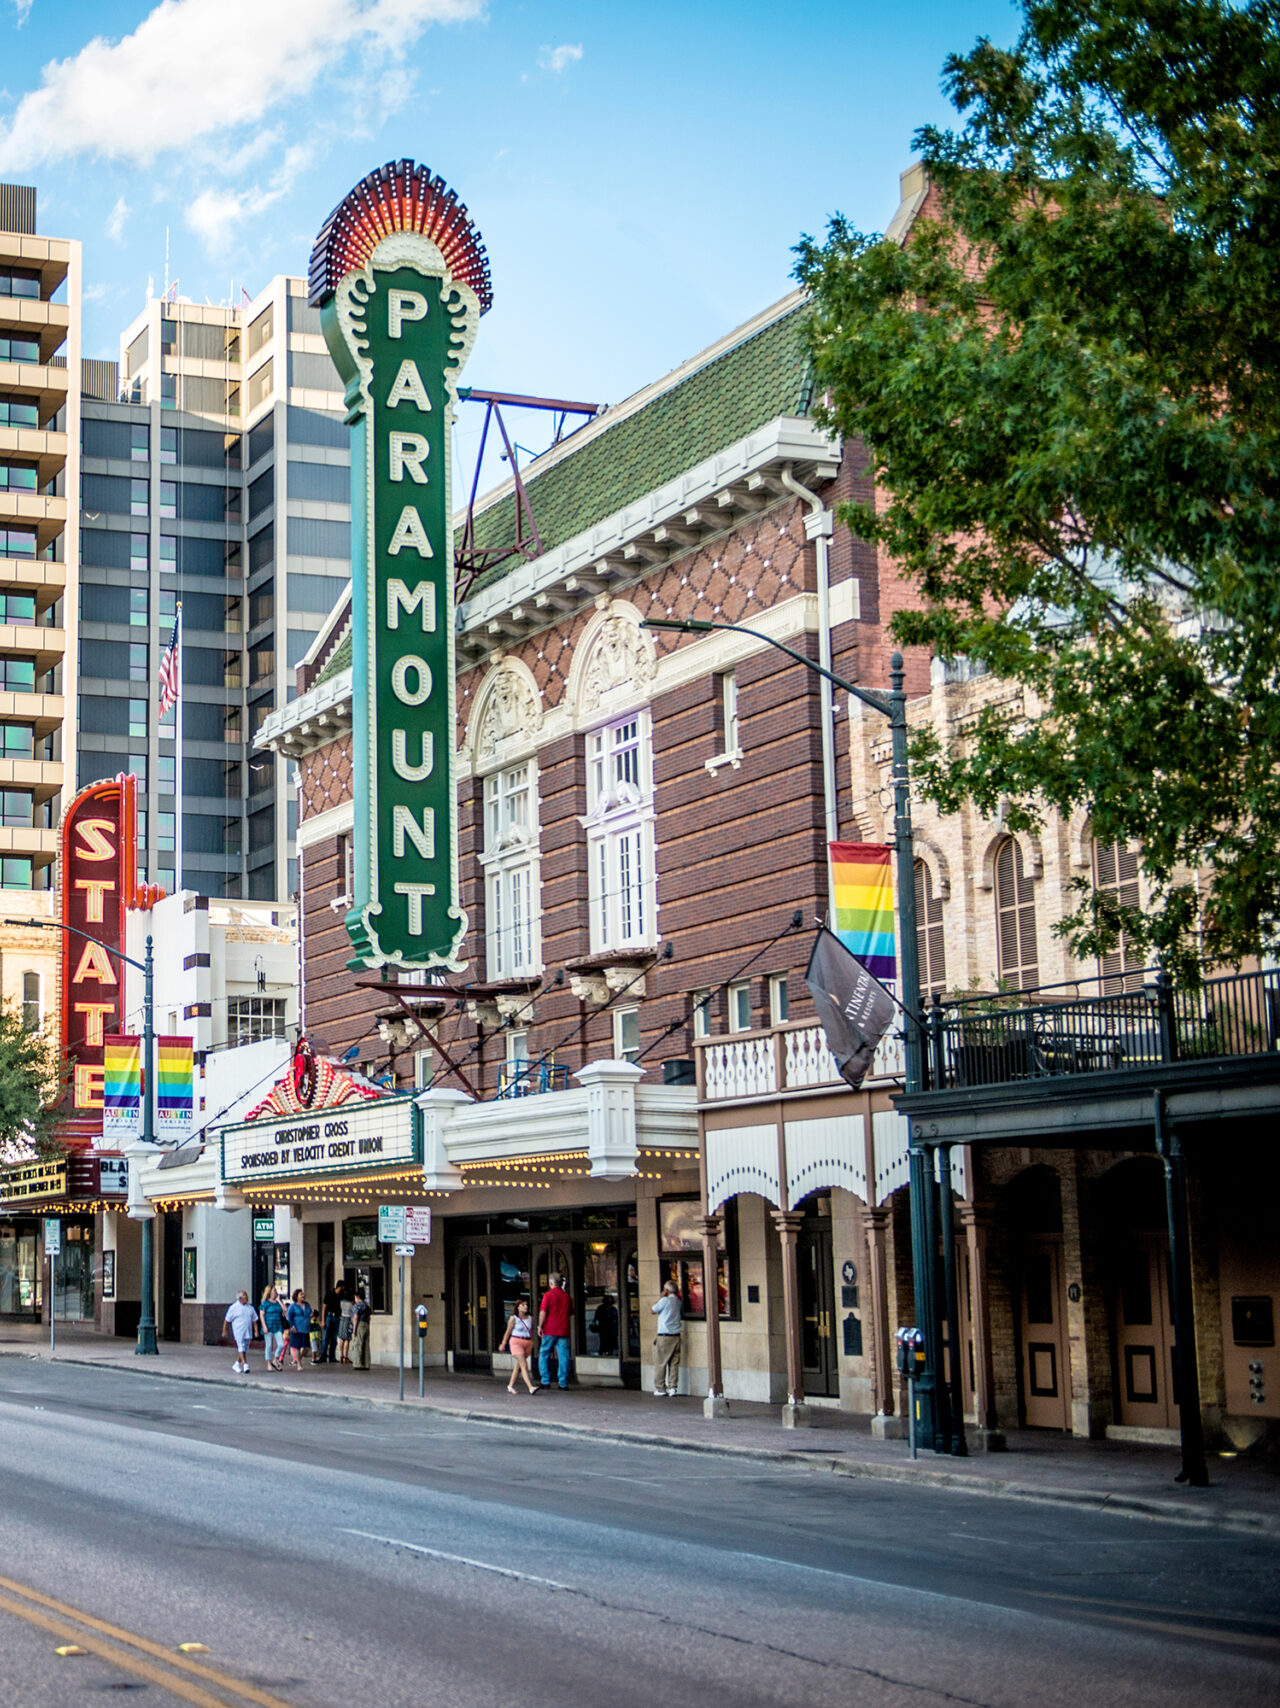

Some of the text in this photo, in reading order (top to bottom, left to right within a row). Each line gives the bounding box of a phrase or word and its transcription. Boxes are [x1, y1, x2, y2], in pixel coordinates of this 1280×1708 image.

[387, 289, 437, 936] PARAMOUNT
[72, 818, 118, 1110] STATE
[105, 1109, 139, 1118] AUSTIN
[158, 1110, 192, 1119] AUSTIN
[275, 1120, 349, 1145] CHRISTOPHER CROSS
[241, 1136, 383, 1169] SPONSORED BY VELOCITY CREDIT UNION
[101, 1161, 128, 1173] BLA
[256, 1222, 273, 1230] ATM
